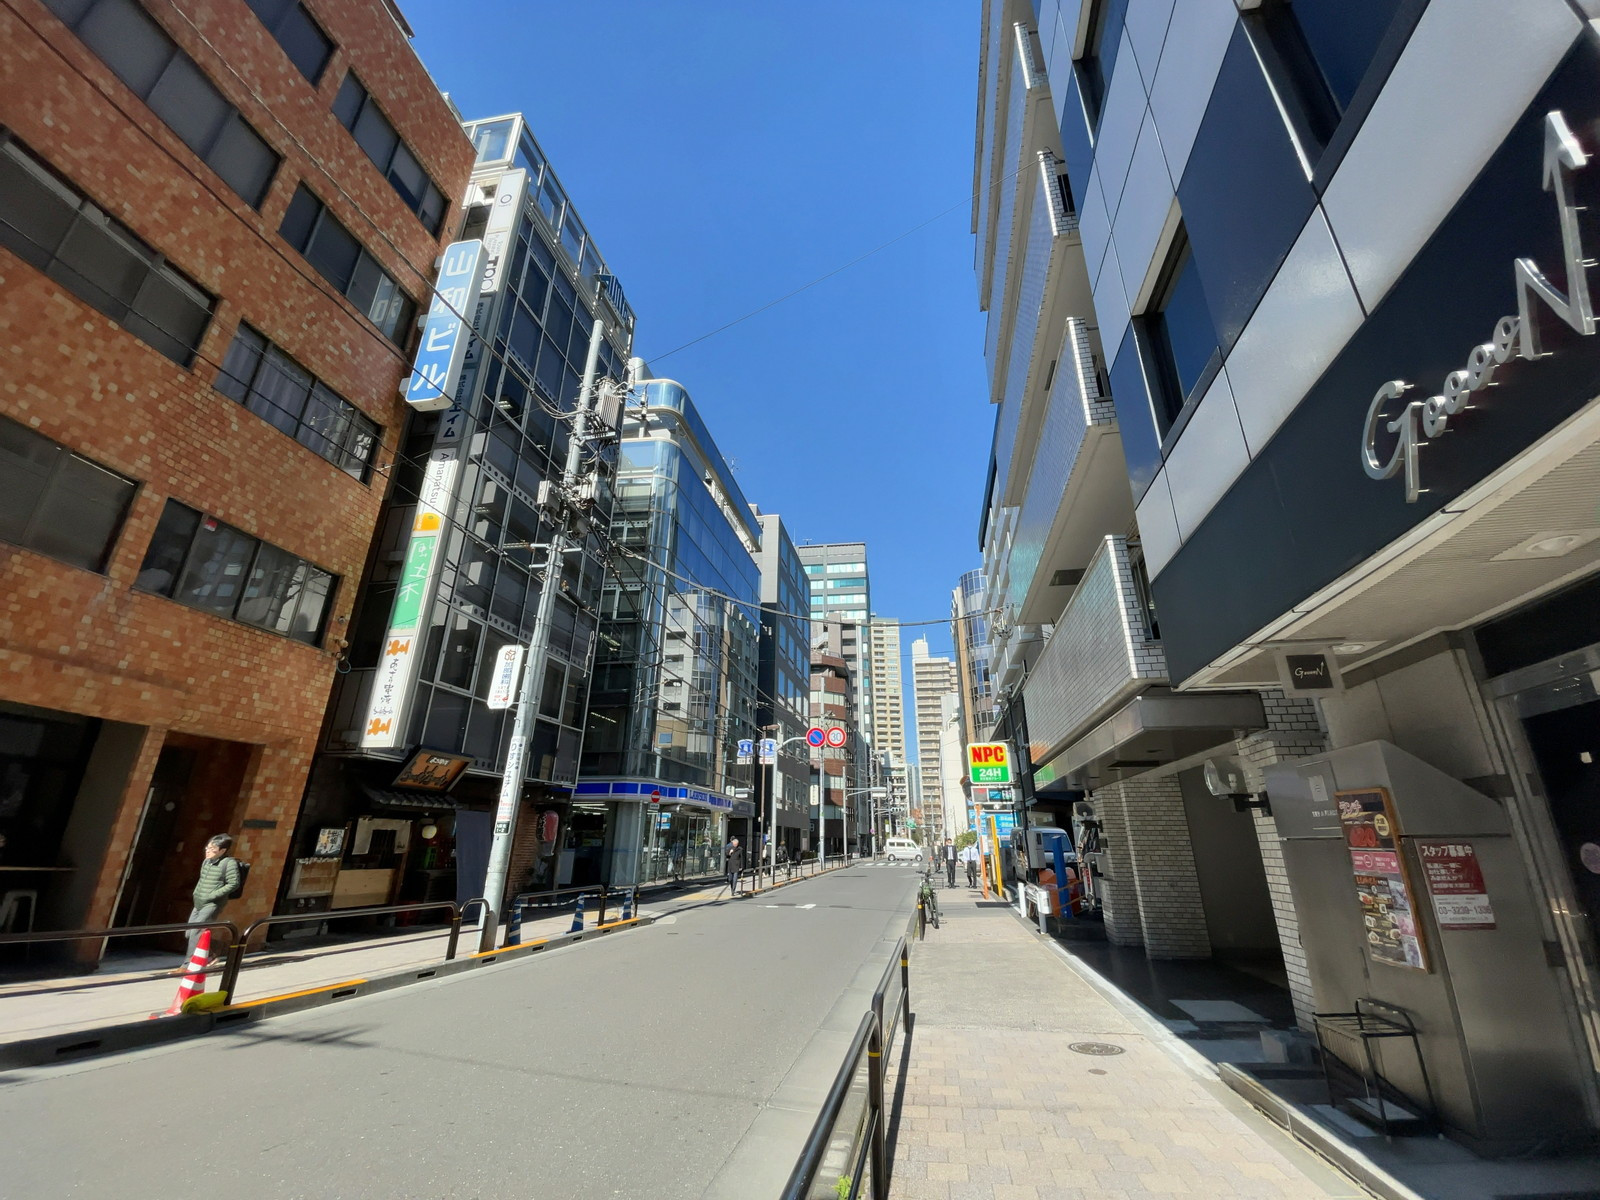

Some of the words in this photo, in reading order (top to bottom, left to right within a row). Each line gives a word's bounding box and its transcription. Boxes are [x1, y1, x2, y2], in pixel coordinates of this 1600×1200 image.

[412, 250, 475, 393] 山和ビル
[430, 452, 450, 504] Amanatsu
[831, 733, 842, 741] 30
[971, 746, 1005, 763] NPC
[979, 768, 1001, 777] 24H
[1421, 844, 1473, 857] スタッフ募集中
